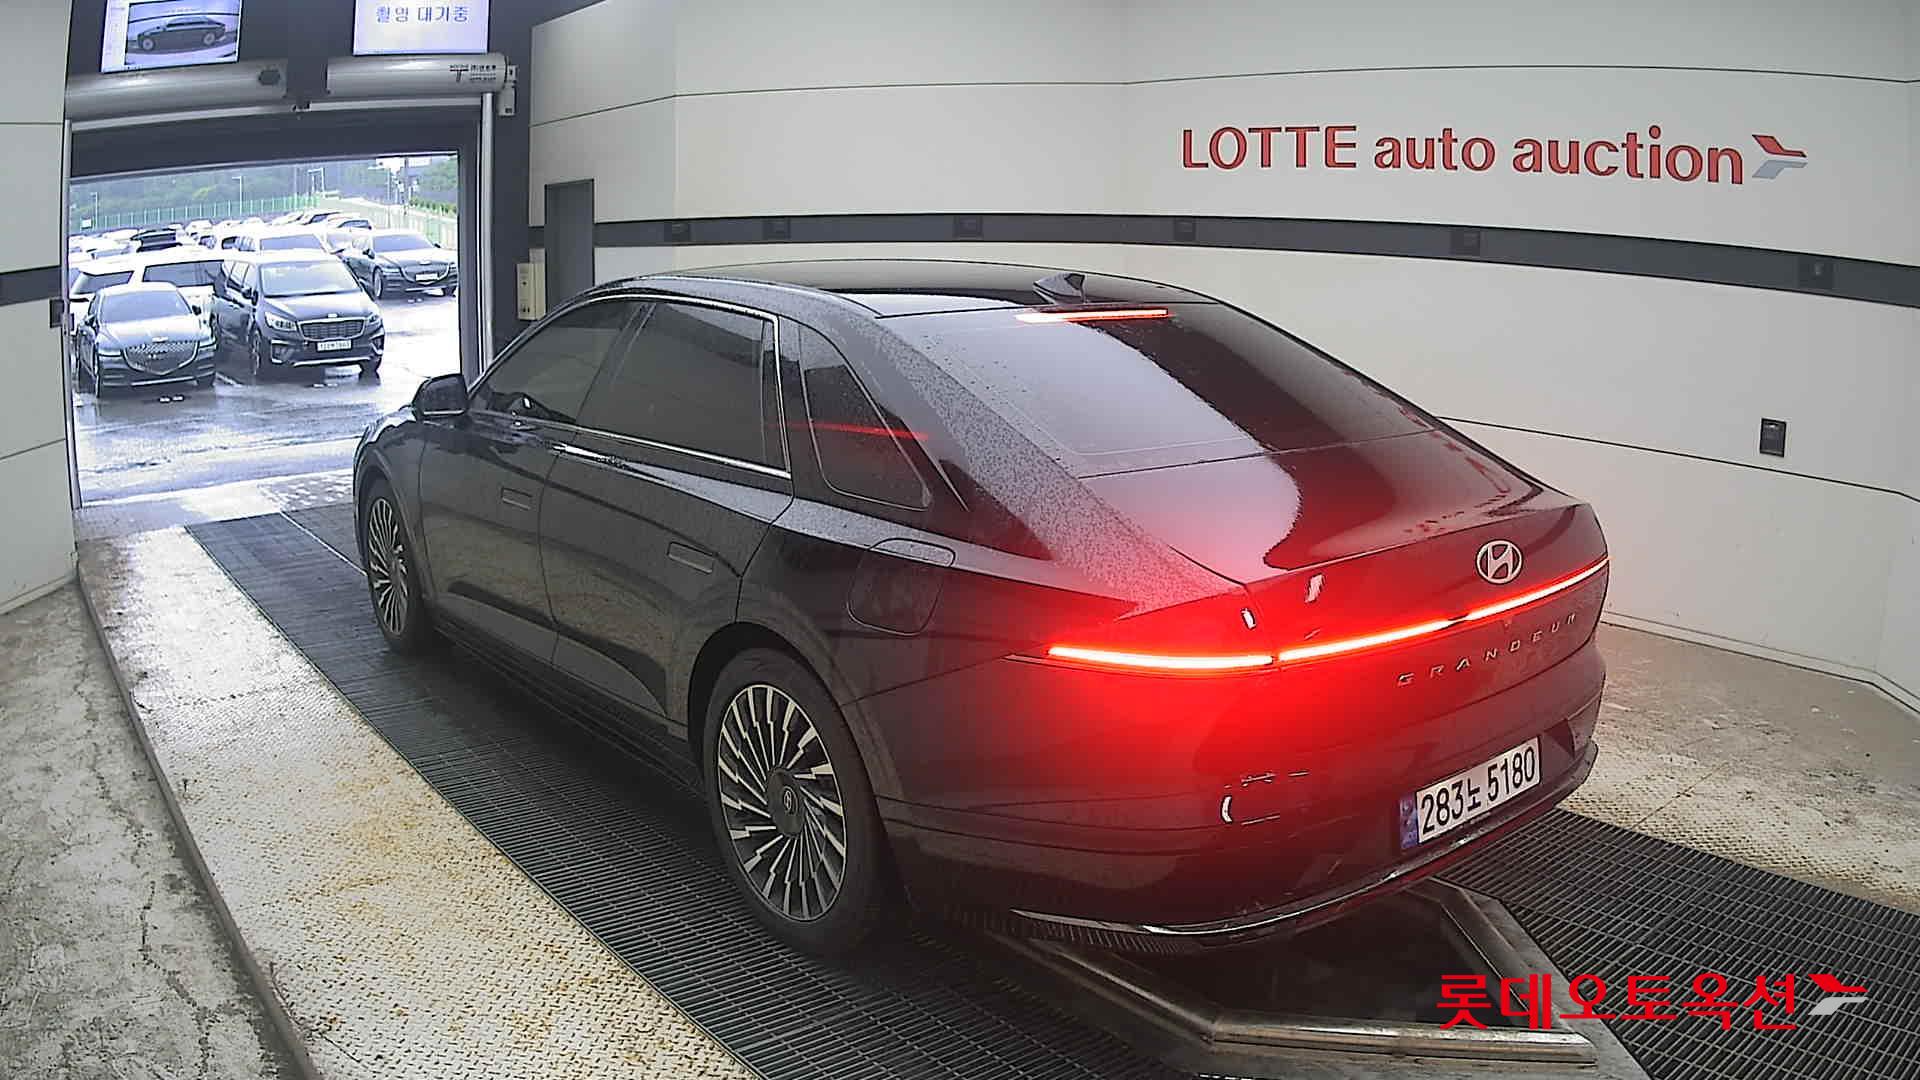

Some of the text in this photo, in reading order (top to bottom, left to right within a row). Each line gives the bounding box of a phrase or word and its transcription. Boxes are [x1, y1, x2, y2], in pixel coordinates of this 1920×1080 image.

[417, 6, 470, 23] 대기중
[1182, 124, 1743, 185] LOTTE auto auction
[1397, 613, 1576, 687] GRANDEUR
[1421, 746, 1536, 835] 283노 5180
